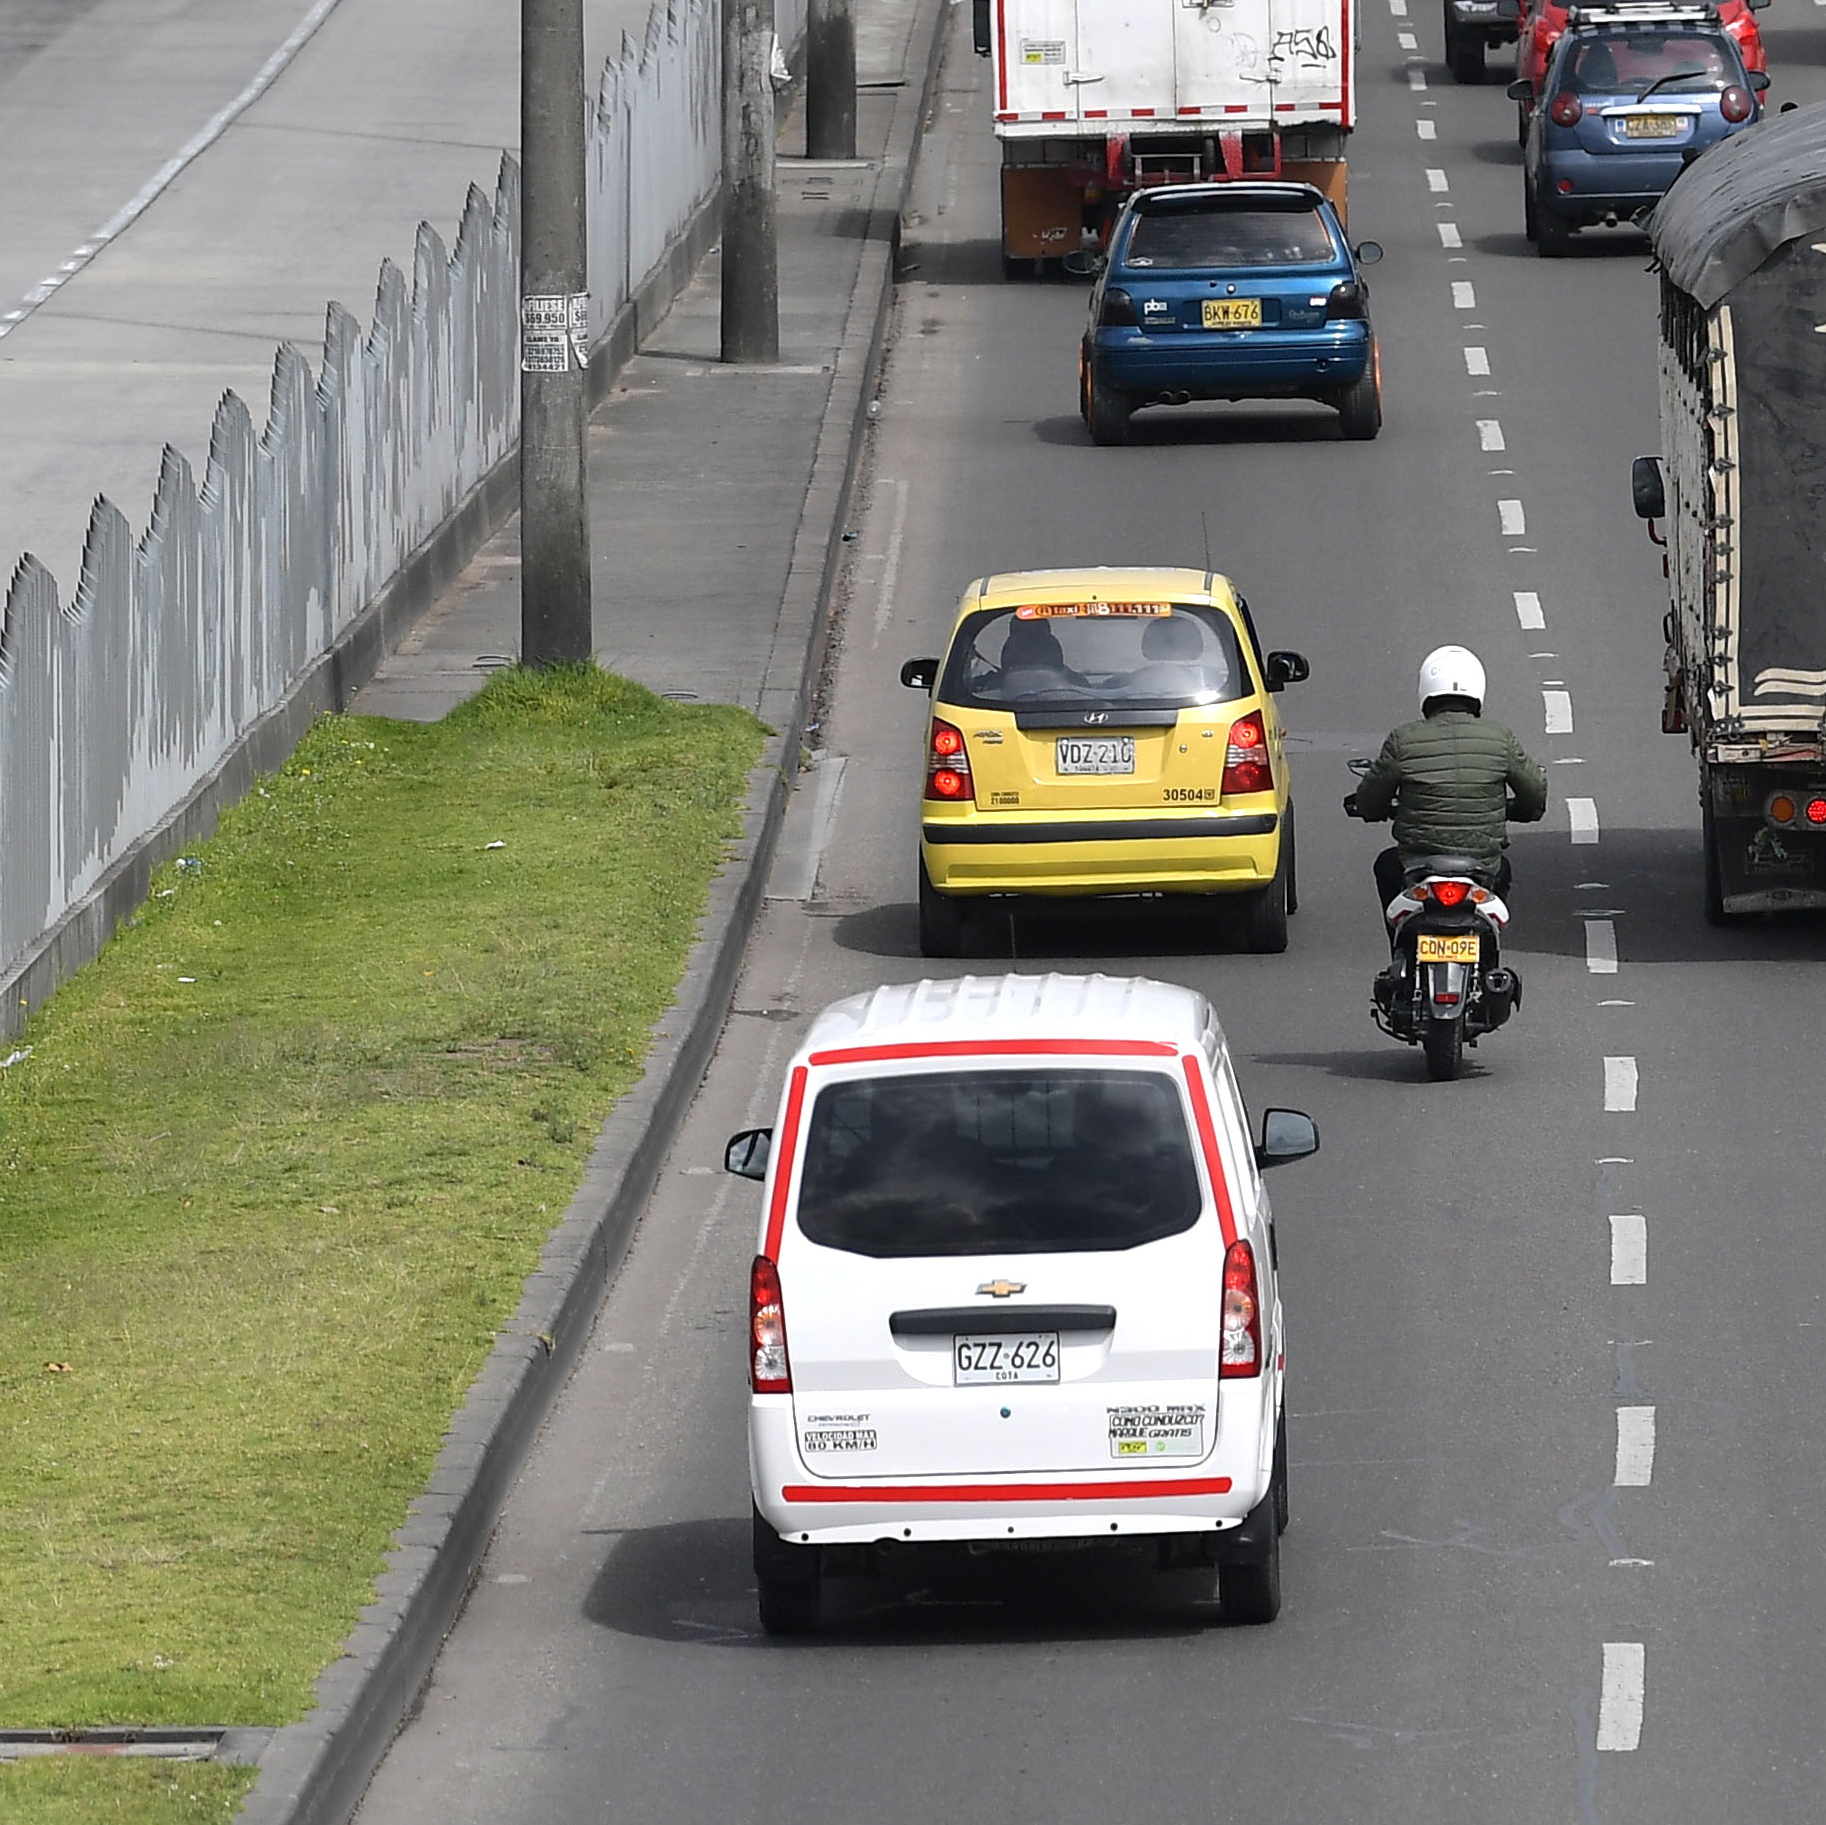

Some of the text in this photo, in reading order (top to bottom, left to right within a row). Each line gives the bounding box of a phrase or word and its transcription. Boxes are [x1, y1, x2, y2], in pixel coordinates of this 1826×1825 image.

[1163, 787, 1203, 802] 30504
[995, 1371, 1020, 1381] COTA
[807, 1413, 871, 1423] CHEVROLET
[1112, 1415, 1141, 1427] COMO
[805, 1431, 855, 1442] VELOCIDAD
[833, 1440, 876, 1451] KM/H
